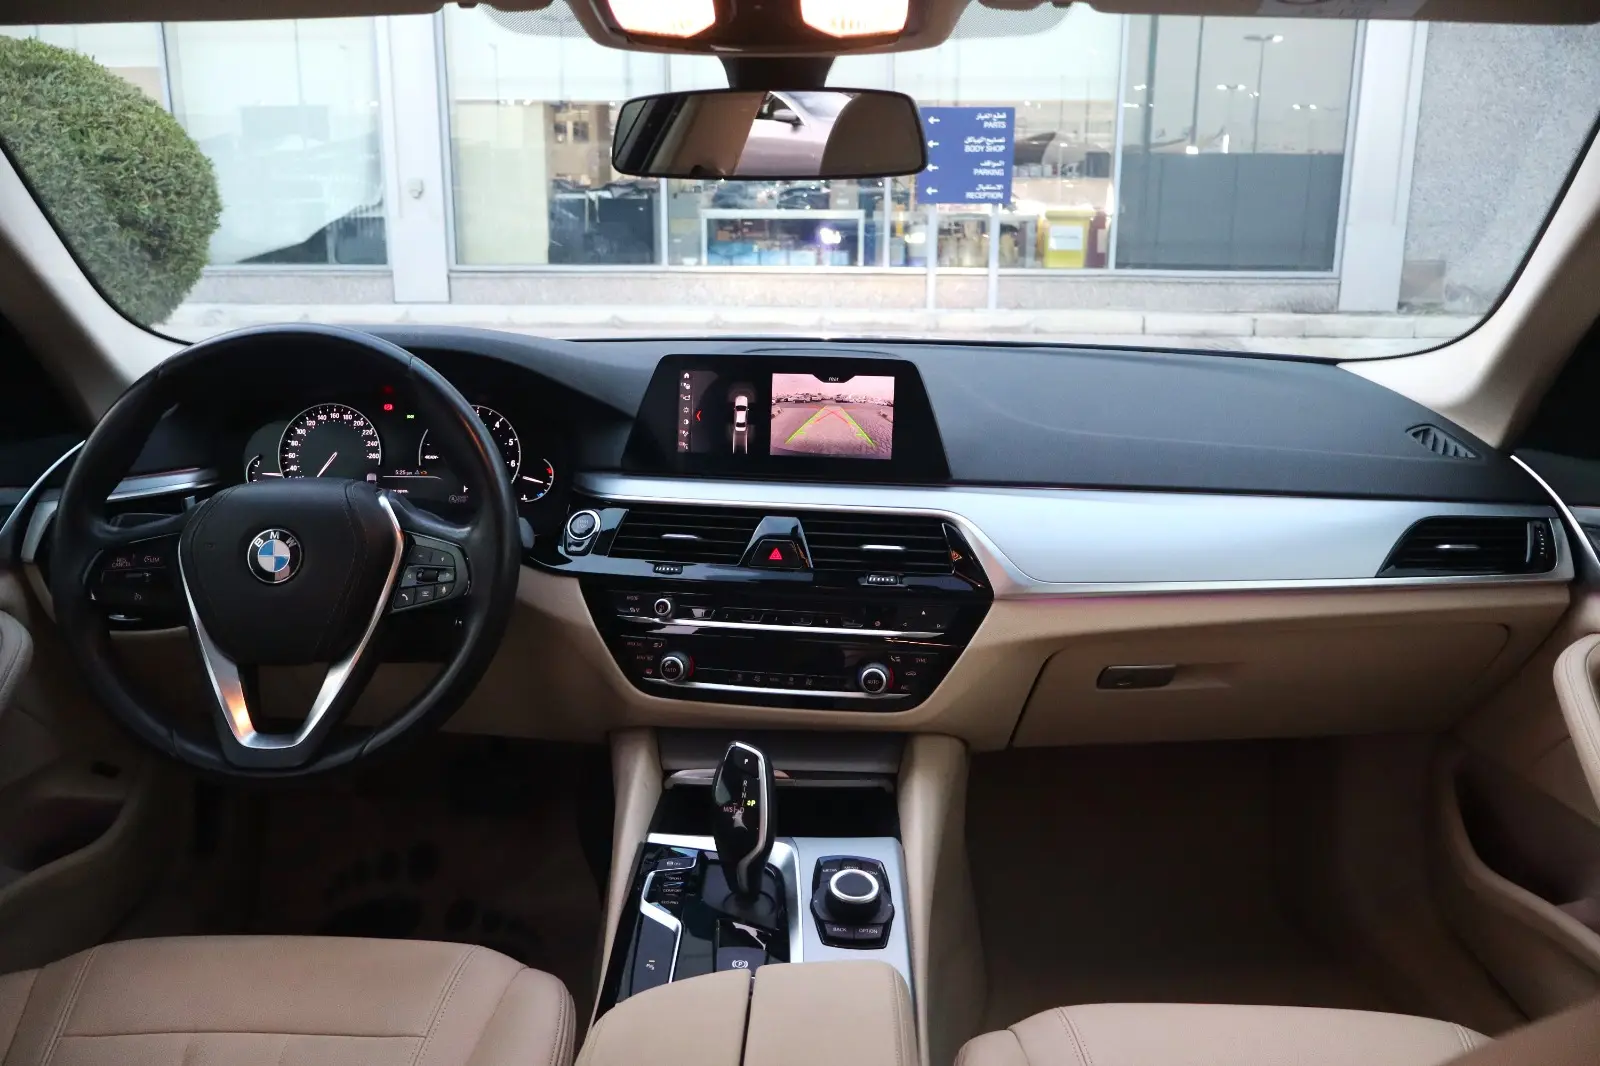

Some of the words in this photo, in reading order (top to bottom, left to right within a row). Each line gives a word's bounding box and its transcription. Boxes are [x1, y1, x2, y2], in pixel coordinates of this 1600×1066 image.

[973, 168, 1004, 176] PARKING
[495, 421, 500, 429] 4
[508, 438, 514, 446] 5
[254, 531, 297, 547] BMW
